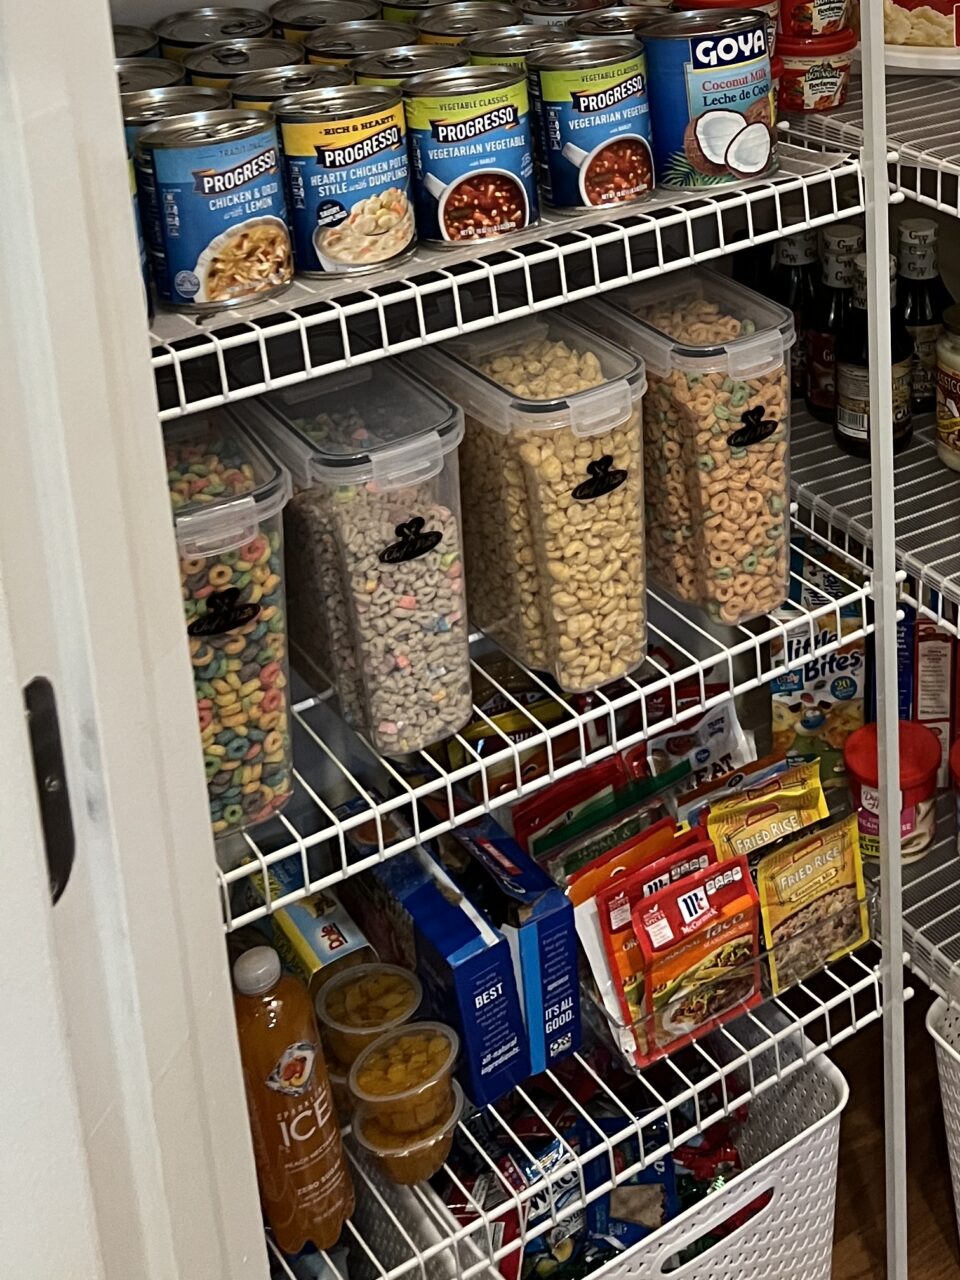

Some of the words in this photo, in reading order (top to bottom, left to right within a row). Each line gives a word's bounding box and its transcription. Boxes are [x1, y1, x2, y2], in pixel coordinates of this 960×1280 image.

[695, 29, 765, 65] GOYA
[581, 69, 615, 83] VEGETABLE
[702, 76, 749, 92] Coconut
[750, 68, 767, 82] Milk
[438, 99, 478, 112] VEGETABLE
[478, 94, 509, 108] CLASSICS
[578, 74, 643, 112] PROGRESSO
[703, 93, 737, 108] Leche
[739, 89, 751, 100] de
[324, 125, 351, 136] RICH
[361, 114, 395, 131] HEARTY
[437, 106, 514, 143] PROGRESSO
[568, 112, 622, 131] VEGETARIAN
[324, 127, 399, 167] PROGRESSO
[427, 144, 484, 161] VEGETARIAN
[484, 134, 526, 151] VEGETABLE
[203, 149, 276, 193] PROGRESSO
[310, 170, 349, 187] HEARTY
[350, 161, 388, 180] CHICKEN
[209, 190, 252, 211] CHICKEN
[253, 187, 261, 199] &
[318, 182, 348, 197] STYLE
[245, 195, 273, 214] LEMON
[804, 650, 861, 683] Bites
[736, 827, 770, 855] FRIED
[770, 815, 801, 838] RICE
[779, 863, 813, 890] FRIED
[814, 846, 841, 868] RICE
[320, 923, 344, 951] Dole
[705, 912, 745, 939] Taco
[474, 982, 503, 1009] BEST
[545, 1004, 560, 1021] IT'S
[560, 996, 574, 1013] ALL
[545, 1009, 575, 1035] GOOD.
[481, 1035, 518, 1066] all-natural
[278, 1090, 333, 1148] ICE
